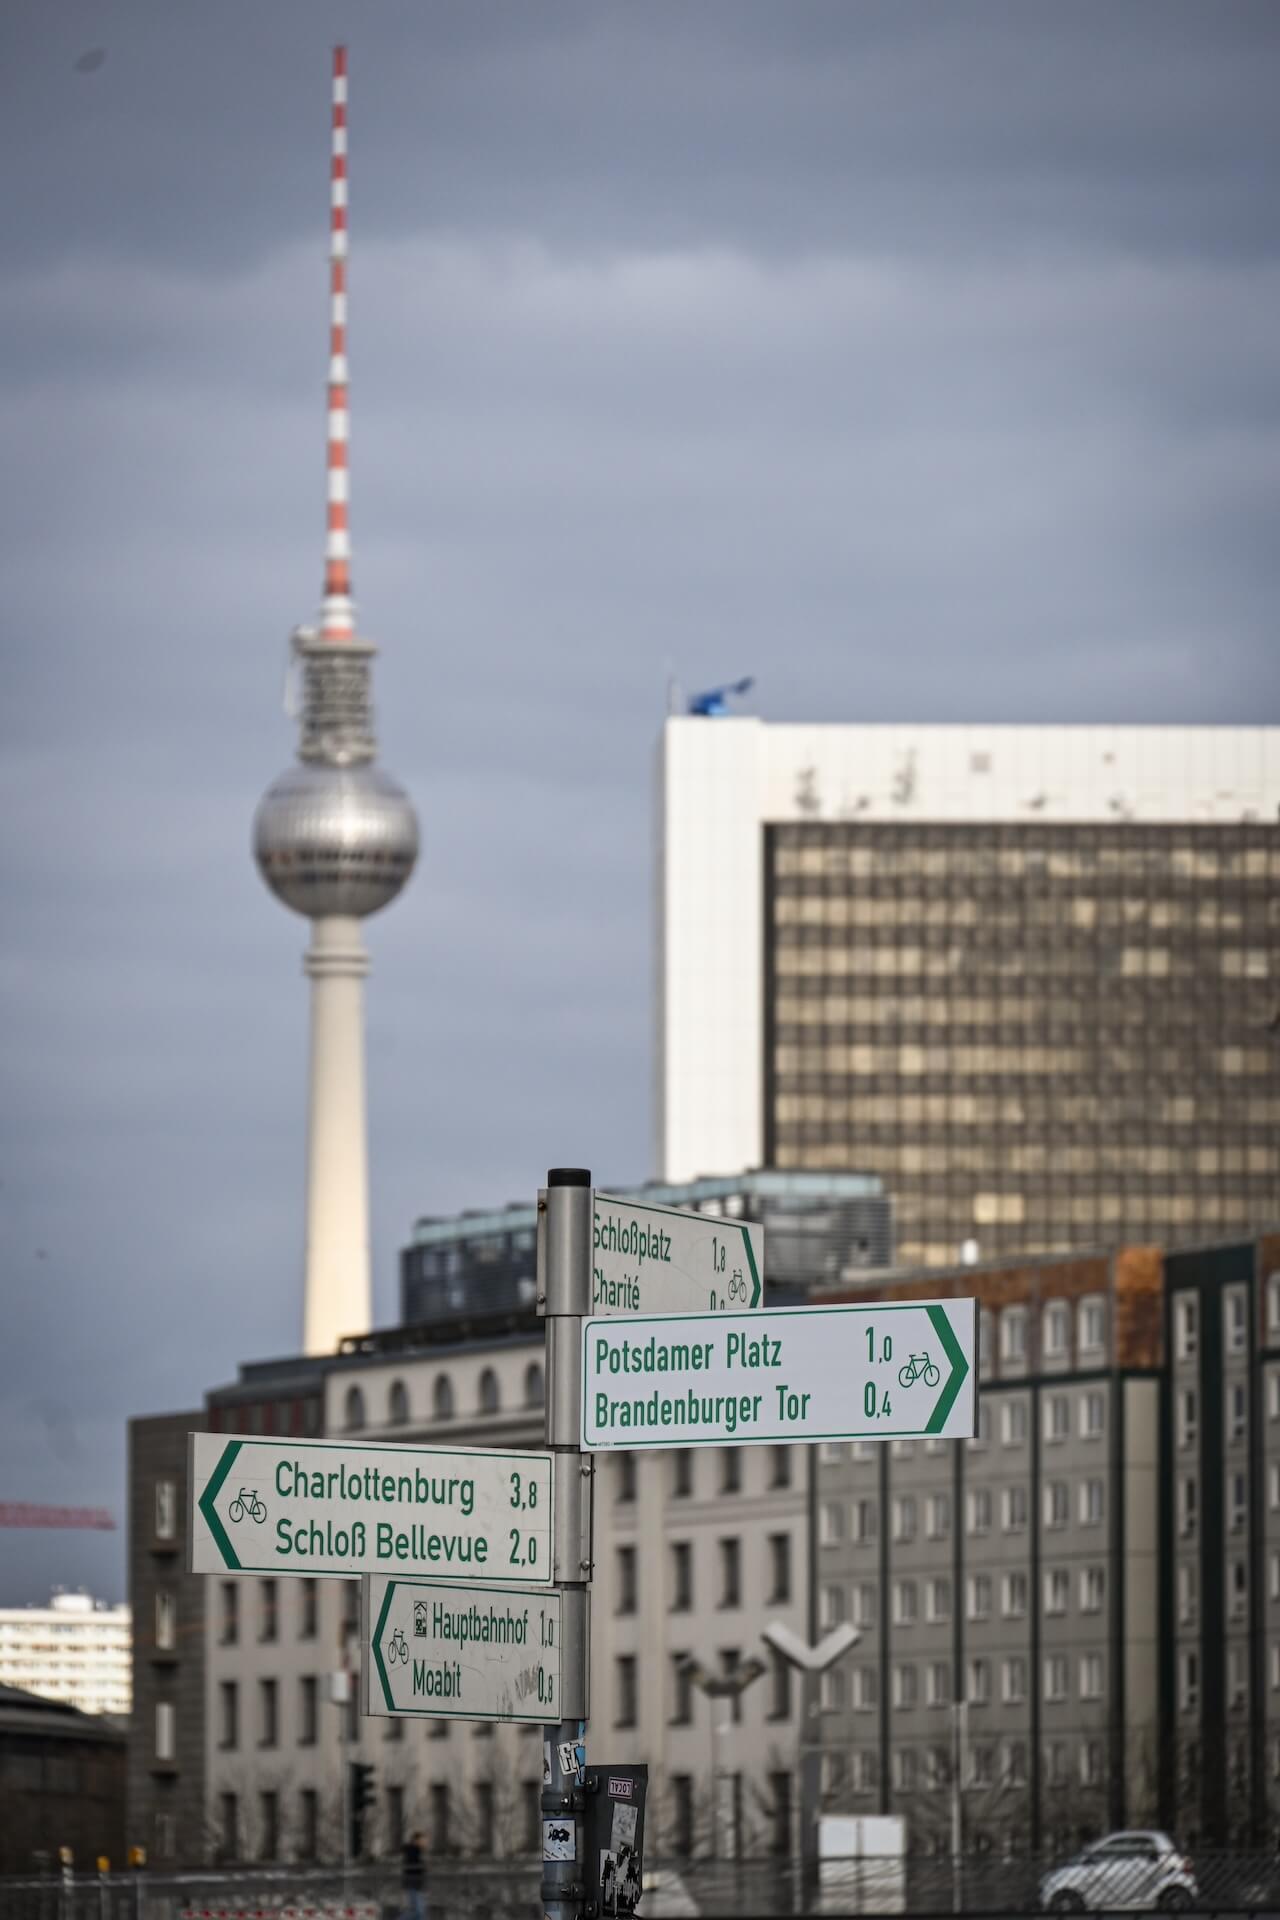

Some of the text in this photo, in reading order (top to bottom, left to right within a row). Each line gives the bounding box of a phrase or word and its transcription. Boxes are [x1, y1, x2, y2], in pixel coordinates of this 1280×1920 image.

[594, 1212, 726, 1273] Schloßplatz 1,8
[596, 1326, 893, 1374] Potsdamer Platz 1,0
[596, 1381, 892, 1433] Brandenburger Tor 0,4
[275, 1460, 537, 1516] Charlottenburg 3,8
[275, 1518, 537, 1566] Schloß Bellevue 2,0
[432, 1601, 554, 1650] Hauptbahnhof 1,0
[413, 1658, 461, 1698] Moabit
[537, 1666, 553, 1704] 0,8
